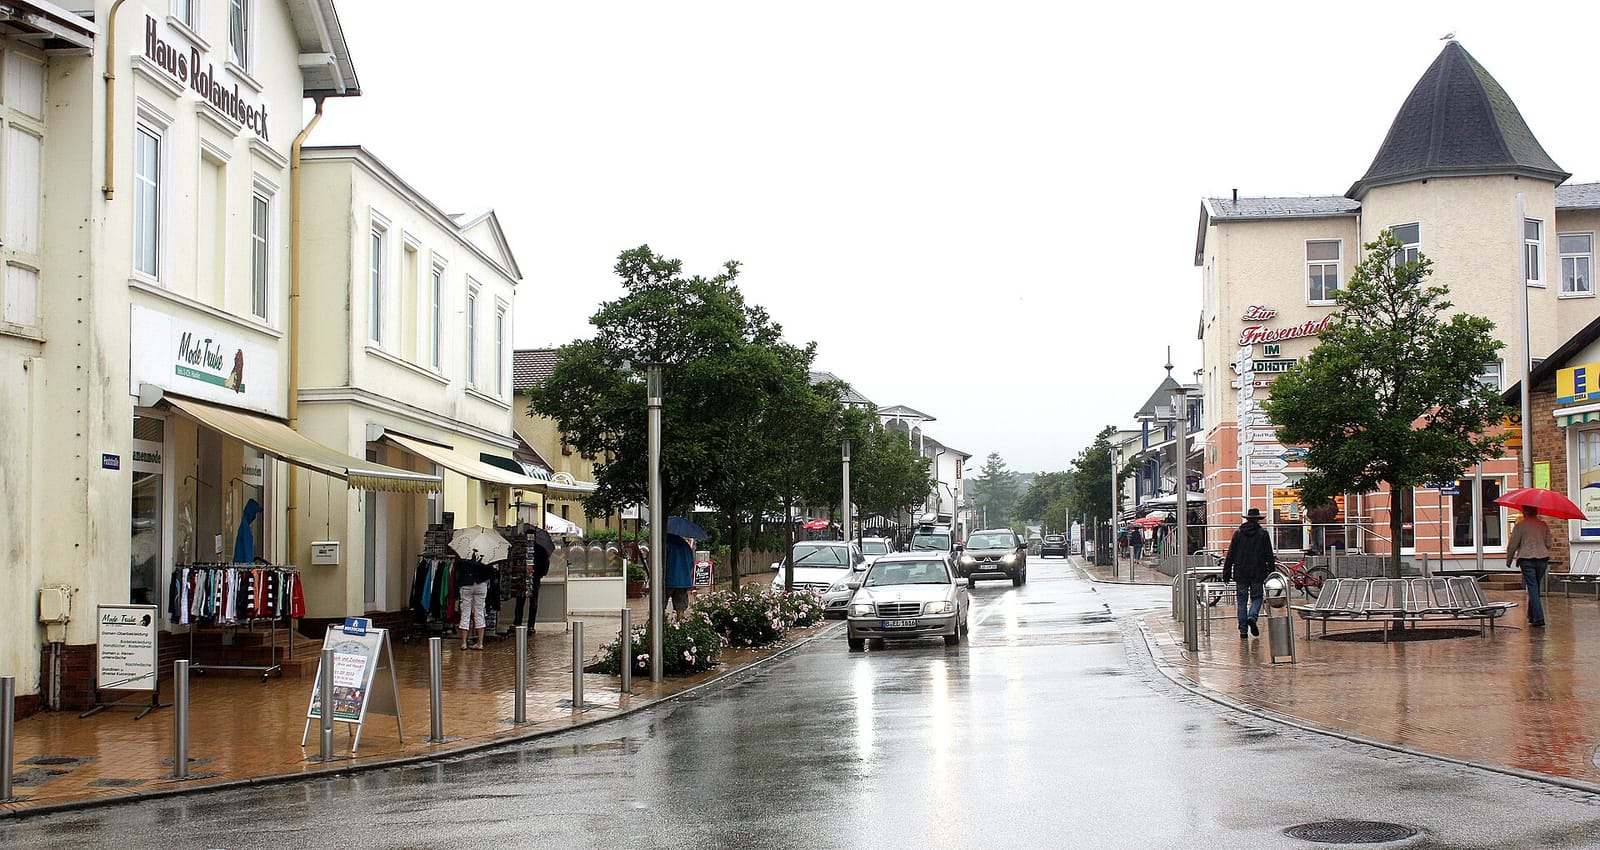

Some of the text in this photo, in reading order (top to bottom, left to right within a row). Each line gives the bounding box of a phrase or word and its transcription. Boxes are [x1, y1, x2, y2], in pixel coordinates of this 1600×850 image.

[145, 14, 269, 142] Haus Rolandseck
[1242, 305, 1276, 320] Zur
[178, 331, 202, 365] Mode
[1264, 345, 1280, 355] IM
[1574, 368, 1586, 394] E
[133, 450, 161, 464] amenmode
